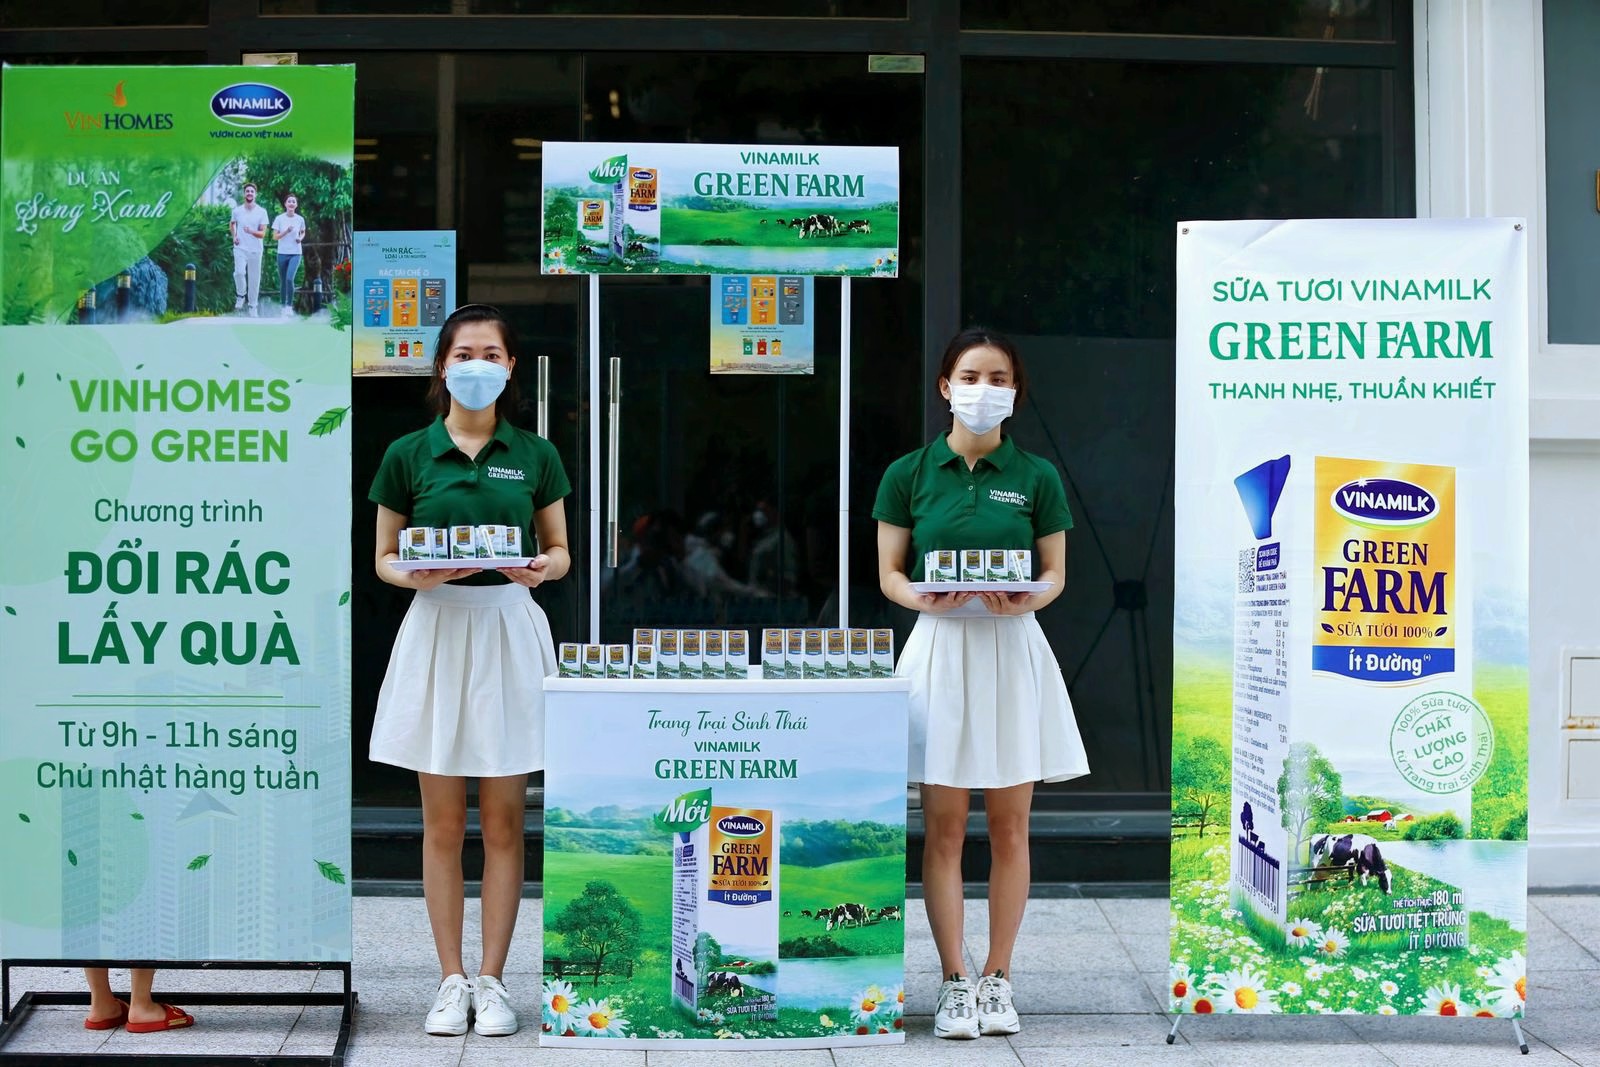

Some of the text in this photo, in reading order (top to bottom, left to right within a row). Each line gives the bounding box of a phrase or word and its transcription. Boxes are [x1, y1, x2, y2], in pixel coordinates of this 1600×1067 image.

[219, 97, 284, 110] VINAMILK
[64, 111, 174, 130] VINHOMES
[254, 129, 272, 139] VIỆT
[596, 161, 626, 178] Mới
[741, 151, 820, 166] VINAMILK
[630, 189, 656, 199] FARM
[694, 172, 865, 198] GREEN FARM
[15, 189, 173, 236] Sống Xanh
[398, 246, 413, 254] RÁC
[379, 268, 393, 277] RÁC
[407, 267, 421, 276] CHẾ
[1213, 277, 1492, 302] SỮA TƯƠI VINAMILK
[1209, 320, 1493, 360] GREEN FARM
[70, 379, 291, 413] VINHOMES
[1209, 375, 1496, 402] THANH NHẸ, THUẦN KHIẾT
[70, 428, 288, 463] GO GREEN
[488, 466, 523, 476] VINAMILK
[989, 495, 1009, 503] GREEN
[990, 489, 1026, 500] VINAMILK
[1342, 490, 1430, 513] VINAMILK
[94, 499, 263, 528] Chương trình
[1343, 539, 1429, 566] GREEN
[64, 537, 290, 595] ĐỔI RÁC
[1321, 566, 1448, 616] FARM
[58, 601, 301, 666] LẤY QUÀ
[1337, 621, 1433, 639] SỮA TƯƠI 100%
[1349, 649, 1362, 671] Ít
[648, 709, 808, 737] Trang Trại Sinh Thái
[1397, 698, 1471, 732] 100% Sữa tươi
[1415, 715, 1452, 738] CHẤT
[58, 721, 96, 747] Từ
[102, 721, 137, 747] 9h
[166, 721, 219, 747] 11h
[228, 723, 297, 755] sáng
[694, 741, 760, 753] VINAMILK
[1414, 731, 1467, 759] LƯỢNG
[655, 759, 798, 780] GREEN FARM
[1433, 751, 1464, 770] CAO
[37, 760, 319, 795] Chủ nhật hàng tuần
[1403, 763, 1434, 790] Trang
[1460, 761, 1482, 784] Sinh
[663, 799, 711, 823] Mới
[721, 820, 762, 832] VINAMILK
[722, 842, 760, 854] GREEN
[712, 854, 769, 877] FARM
[719, 878, 731, 886] SỮA
[724, 891, 757, 903] Ít Đường
[1432, 890, 1449, 906] 180
[1452, 889, 1464, 905] ml
[1353, 905, 1466, 933] SỮA TƯƠI TIỆT TRÙNG
[1409, 932, 1420, 950] ÍT
